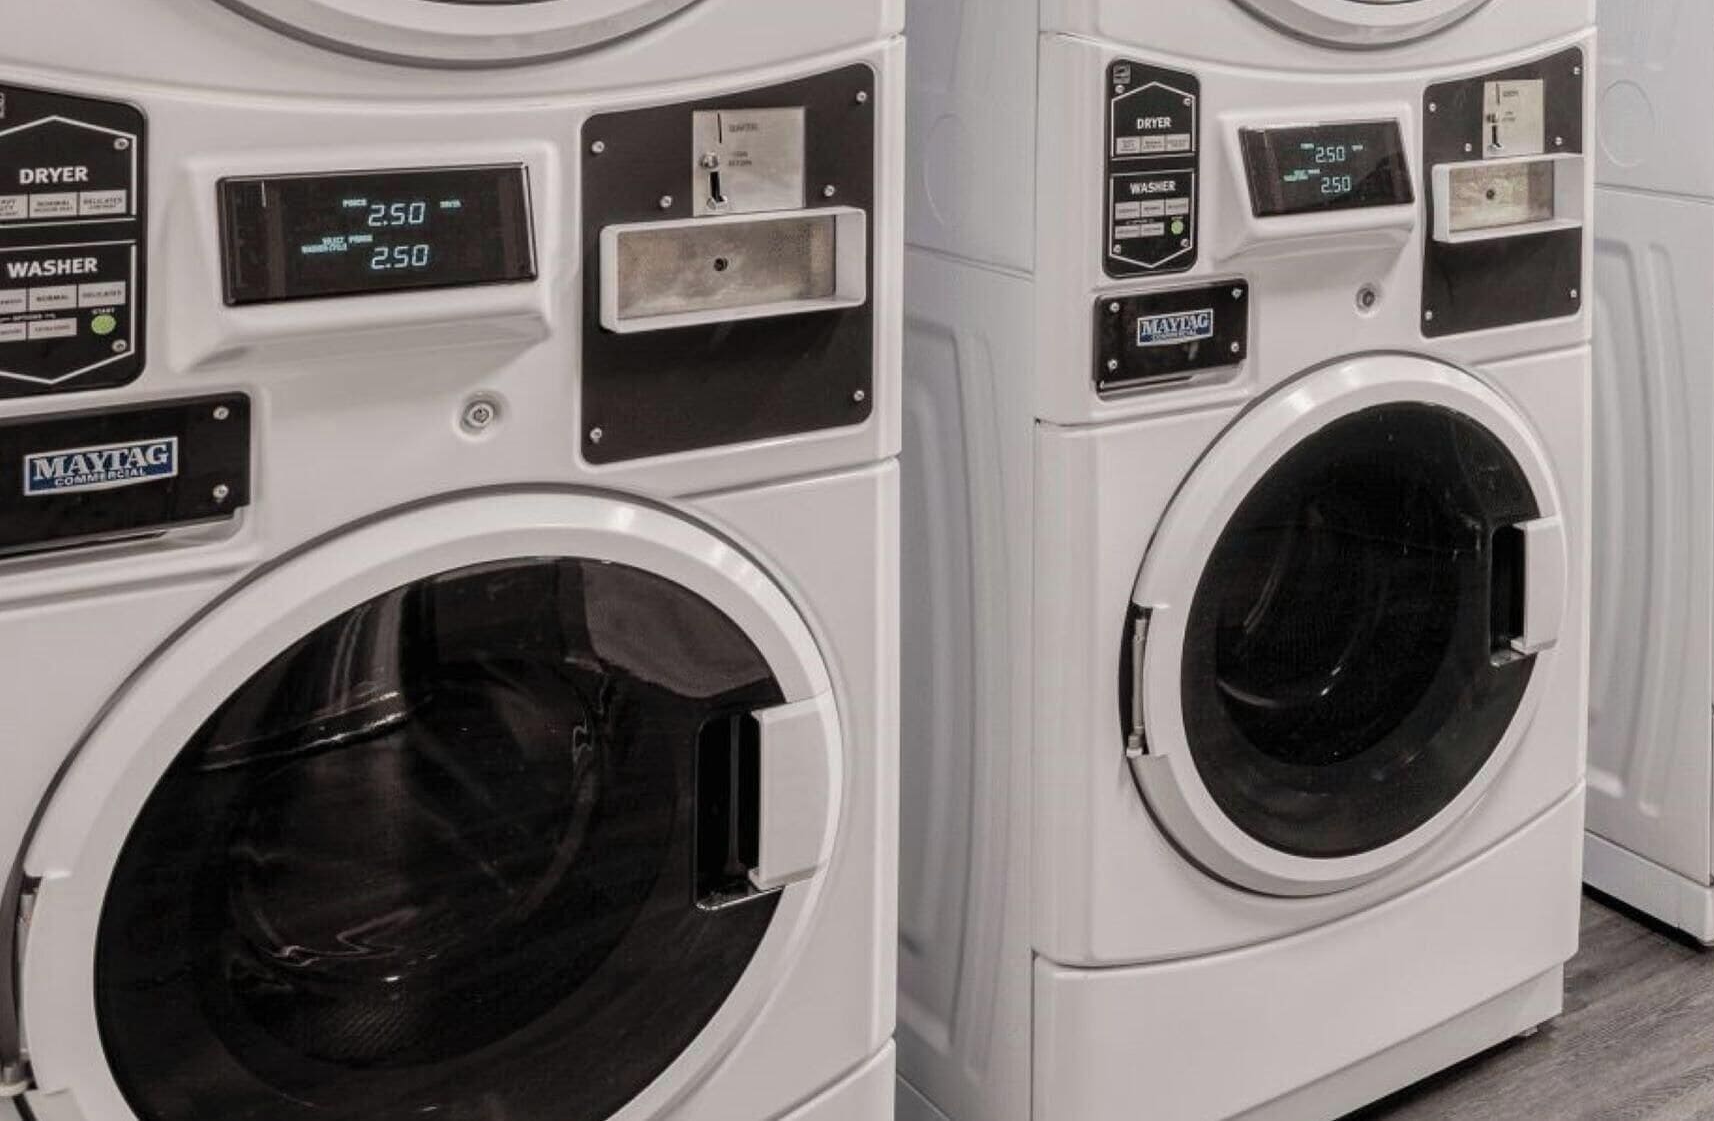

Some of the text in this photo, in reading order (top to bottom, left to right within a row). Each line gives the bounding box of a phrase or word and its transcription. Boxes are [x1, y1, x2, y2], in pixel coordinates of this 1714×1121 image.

[1136, 116, 1172, 130] DRYER
[19, 165, 89, 185] DRYER
[1129, 180, 1176, 195] WASHER
[368, 202, 426, 227] 2.50
[7, 257, 98, 279] WASHER
[371, 244, 430, 270] 2.50
[1141, 313, 1209, 336] MAYTAG
[32, 444, 168, 480] MAYTAG
